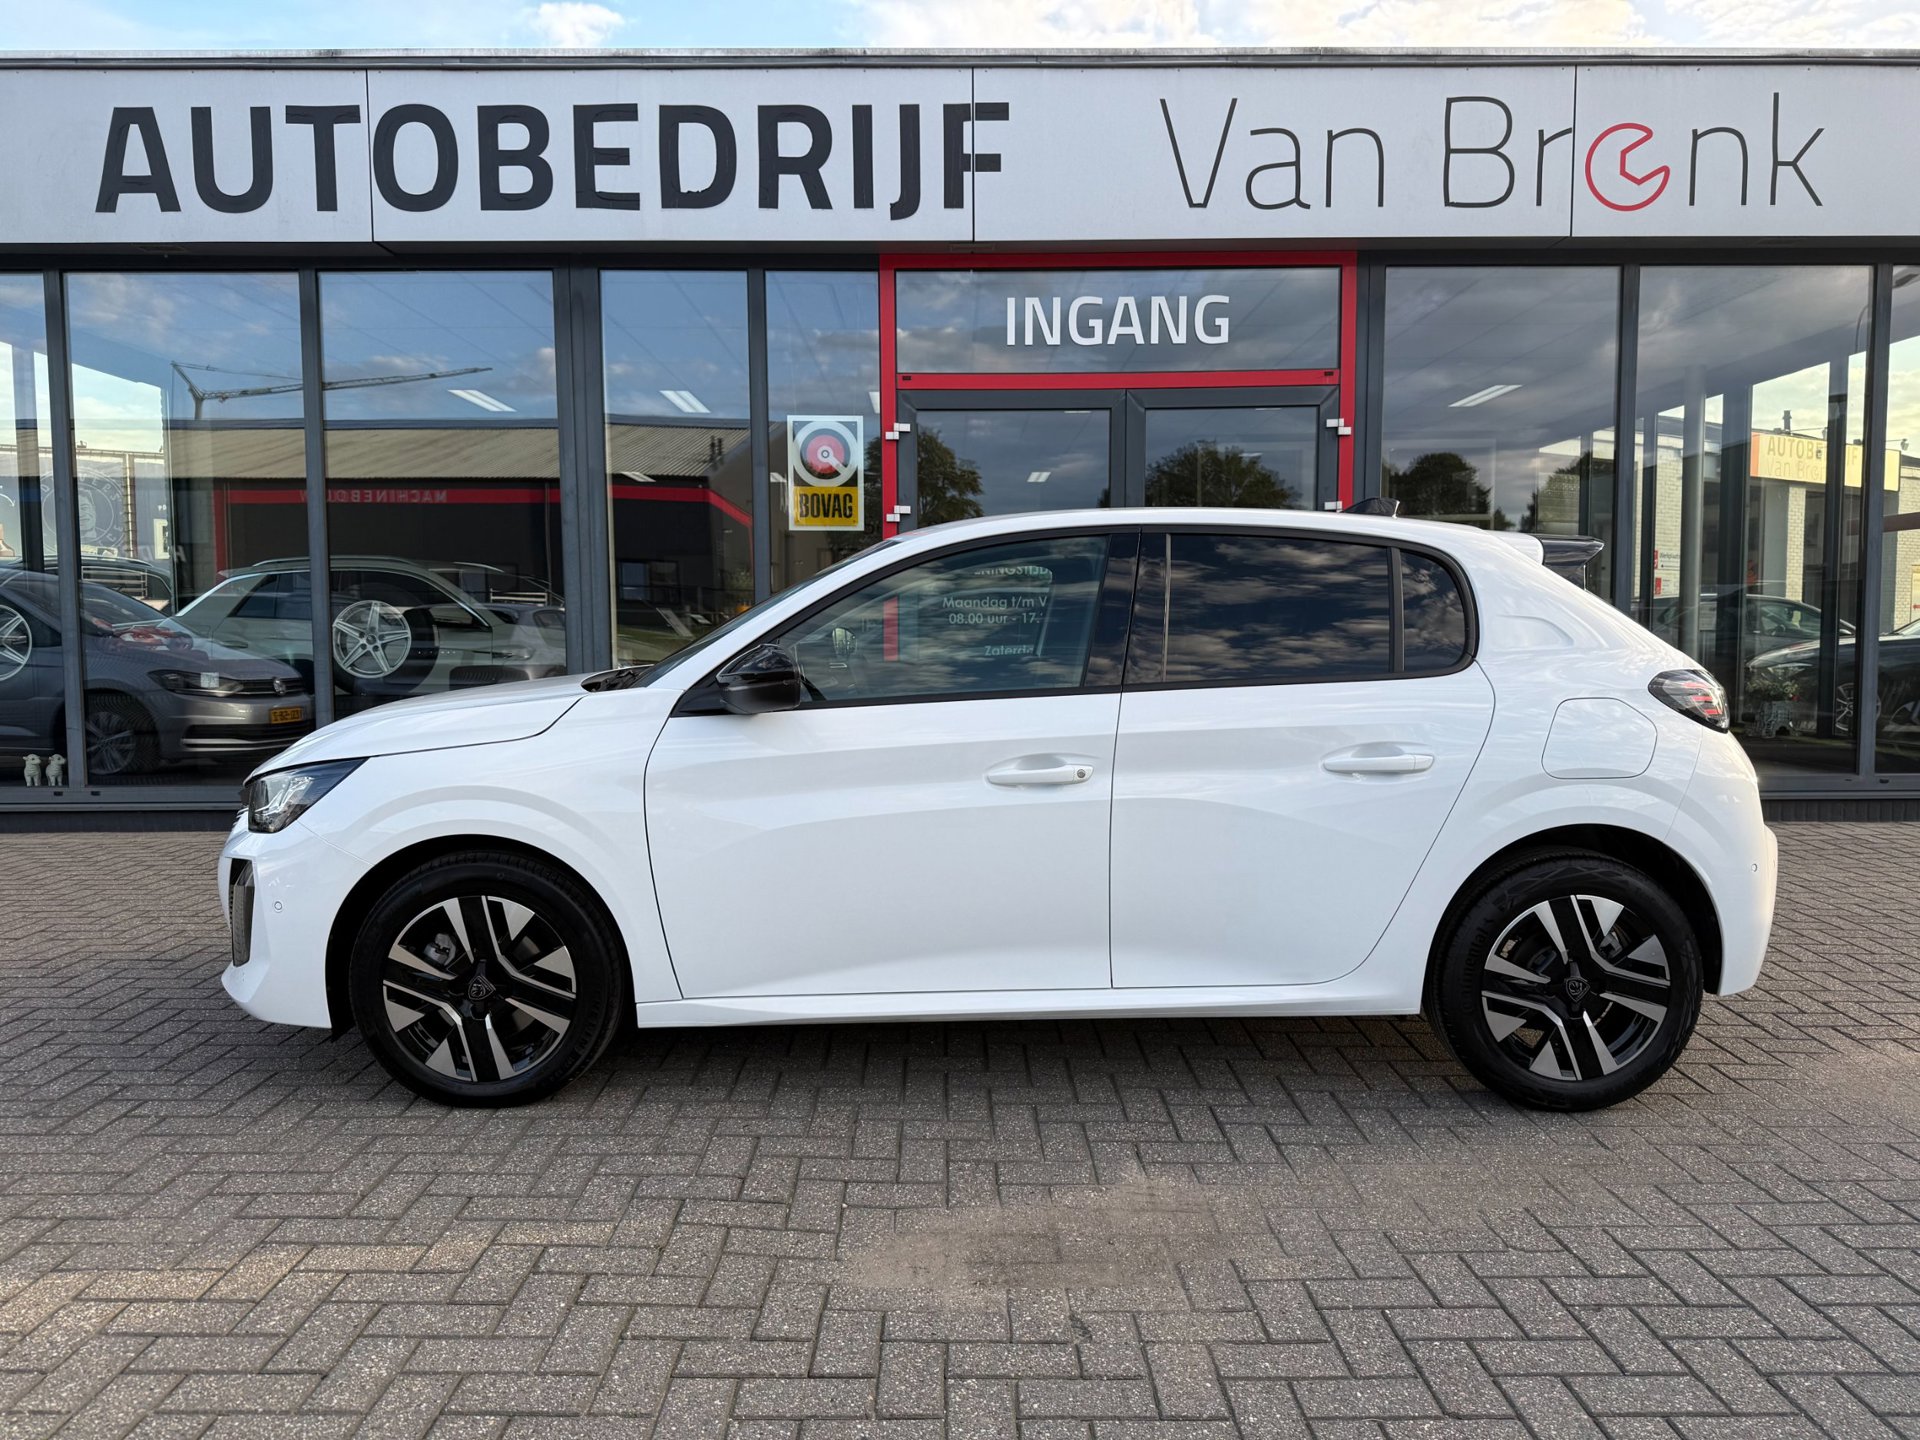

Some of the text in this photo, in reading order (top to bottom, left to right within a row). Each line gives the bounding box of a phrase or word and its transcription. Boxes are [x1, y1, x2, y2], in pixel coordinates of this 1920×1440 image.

[96, 92, 1825, 220] AUTOBEDRIJF Van Bronk
[1007, 295, 1230, 346] INGANG
[799, 493, 853, 518] BOVAG
[942, 596, 1008, 609] Maandag
[1011, 596, 1035, 609] t/m
[948, 612, 984, 624] 08.00
[987, 614, 1008, 624] uur
[1021, 612, 1043, 624] 17.
